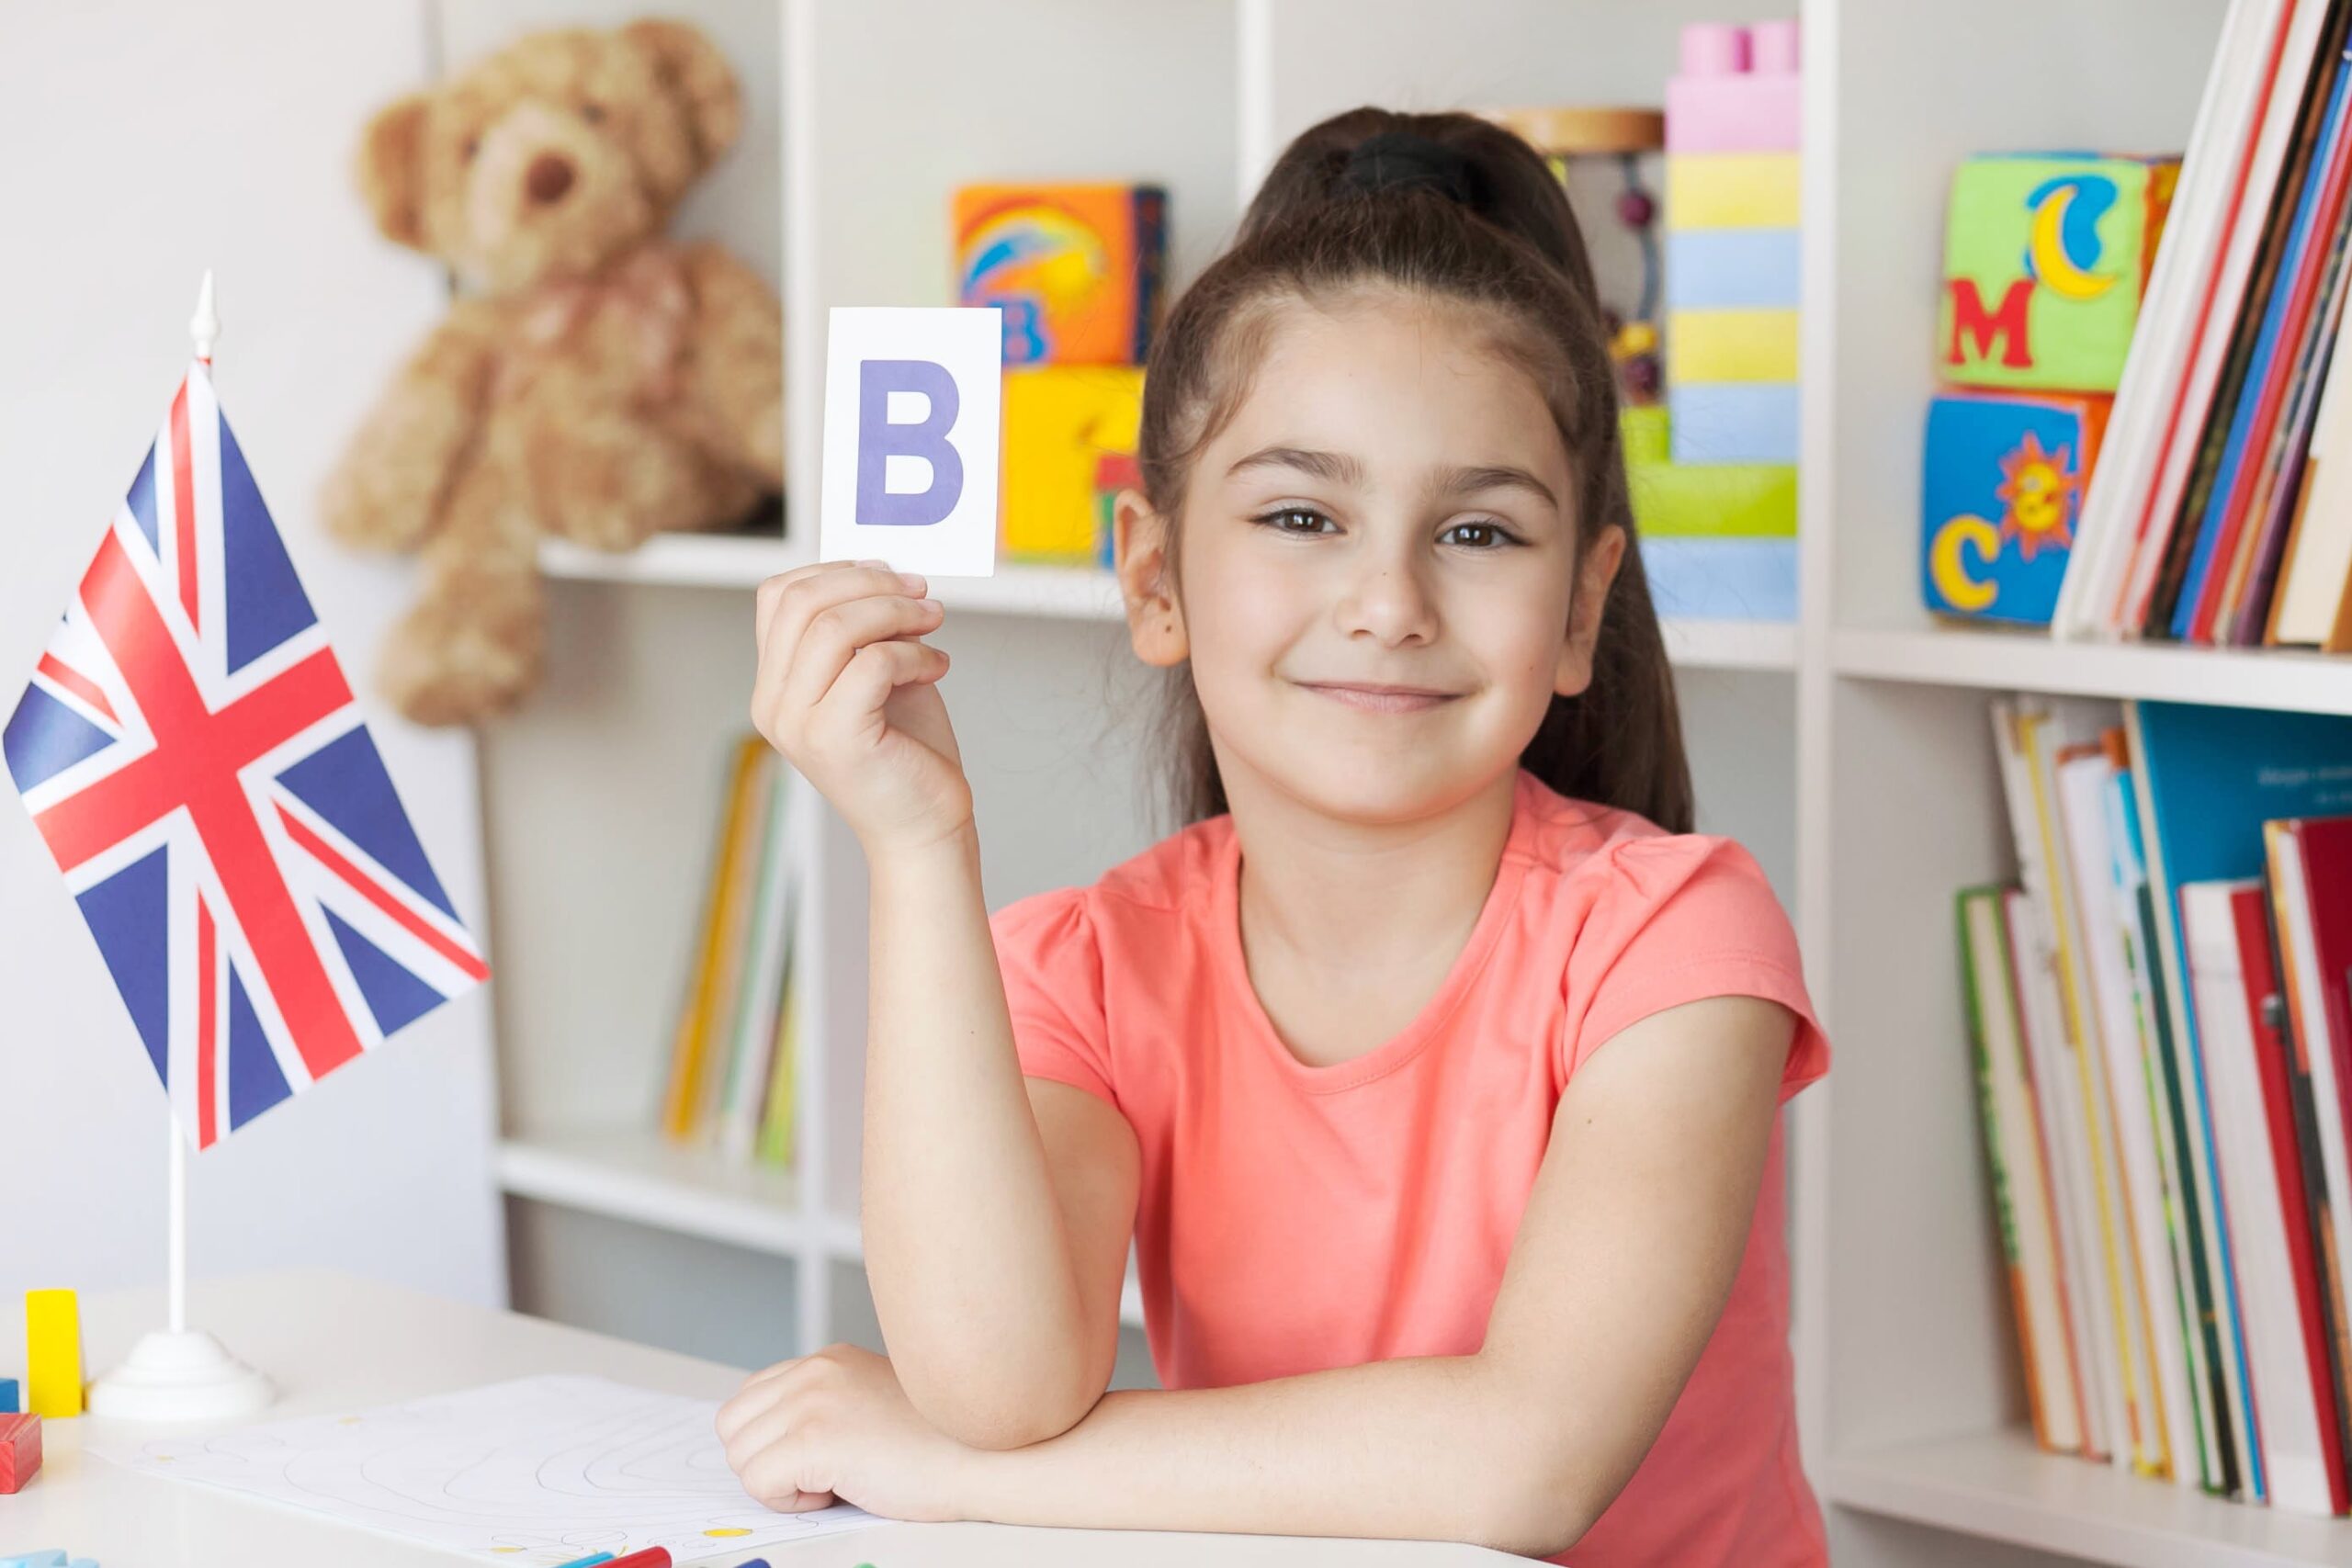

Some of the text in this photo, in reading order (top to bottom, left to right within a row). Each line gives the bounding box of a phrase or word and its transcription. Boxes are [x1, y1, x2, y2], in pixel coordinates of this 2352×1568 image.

[989, 299, 1047, 366] B
[1947, 278, 2036, 368] M
[855, 359, 964, 526] B
[1931, 515, 1998, 610] C
